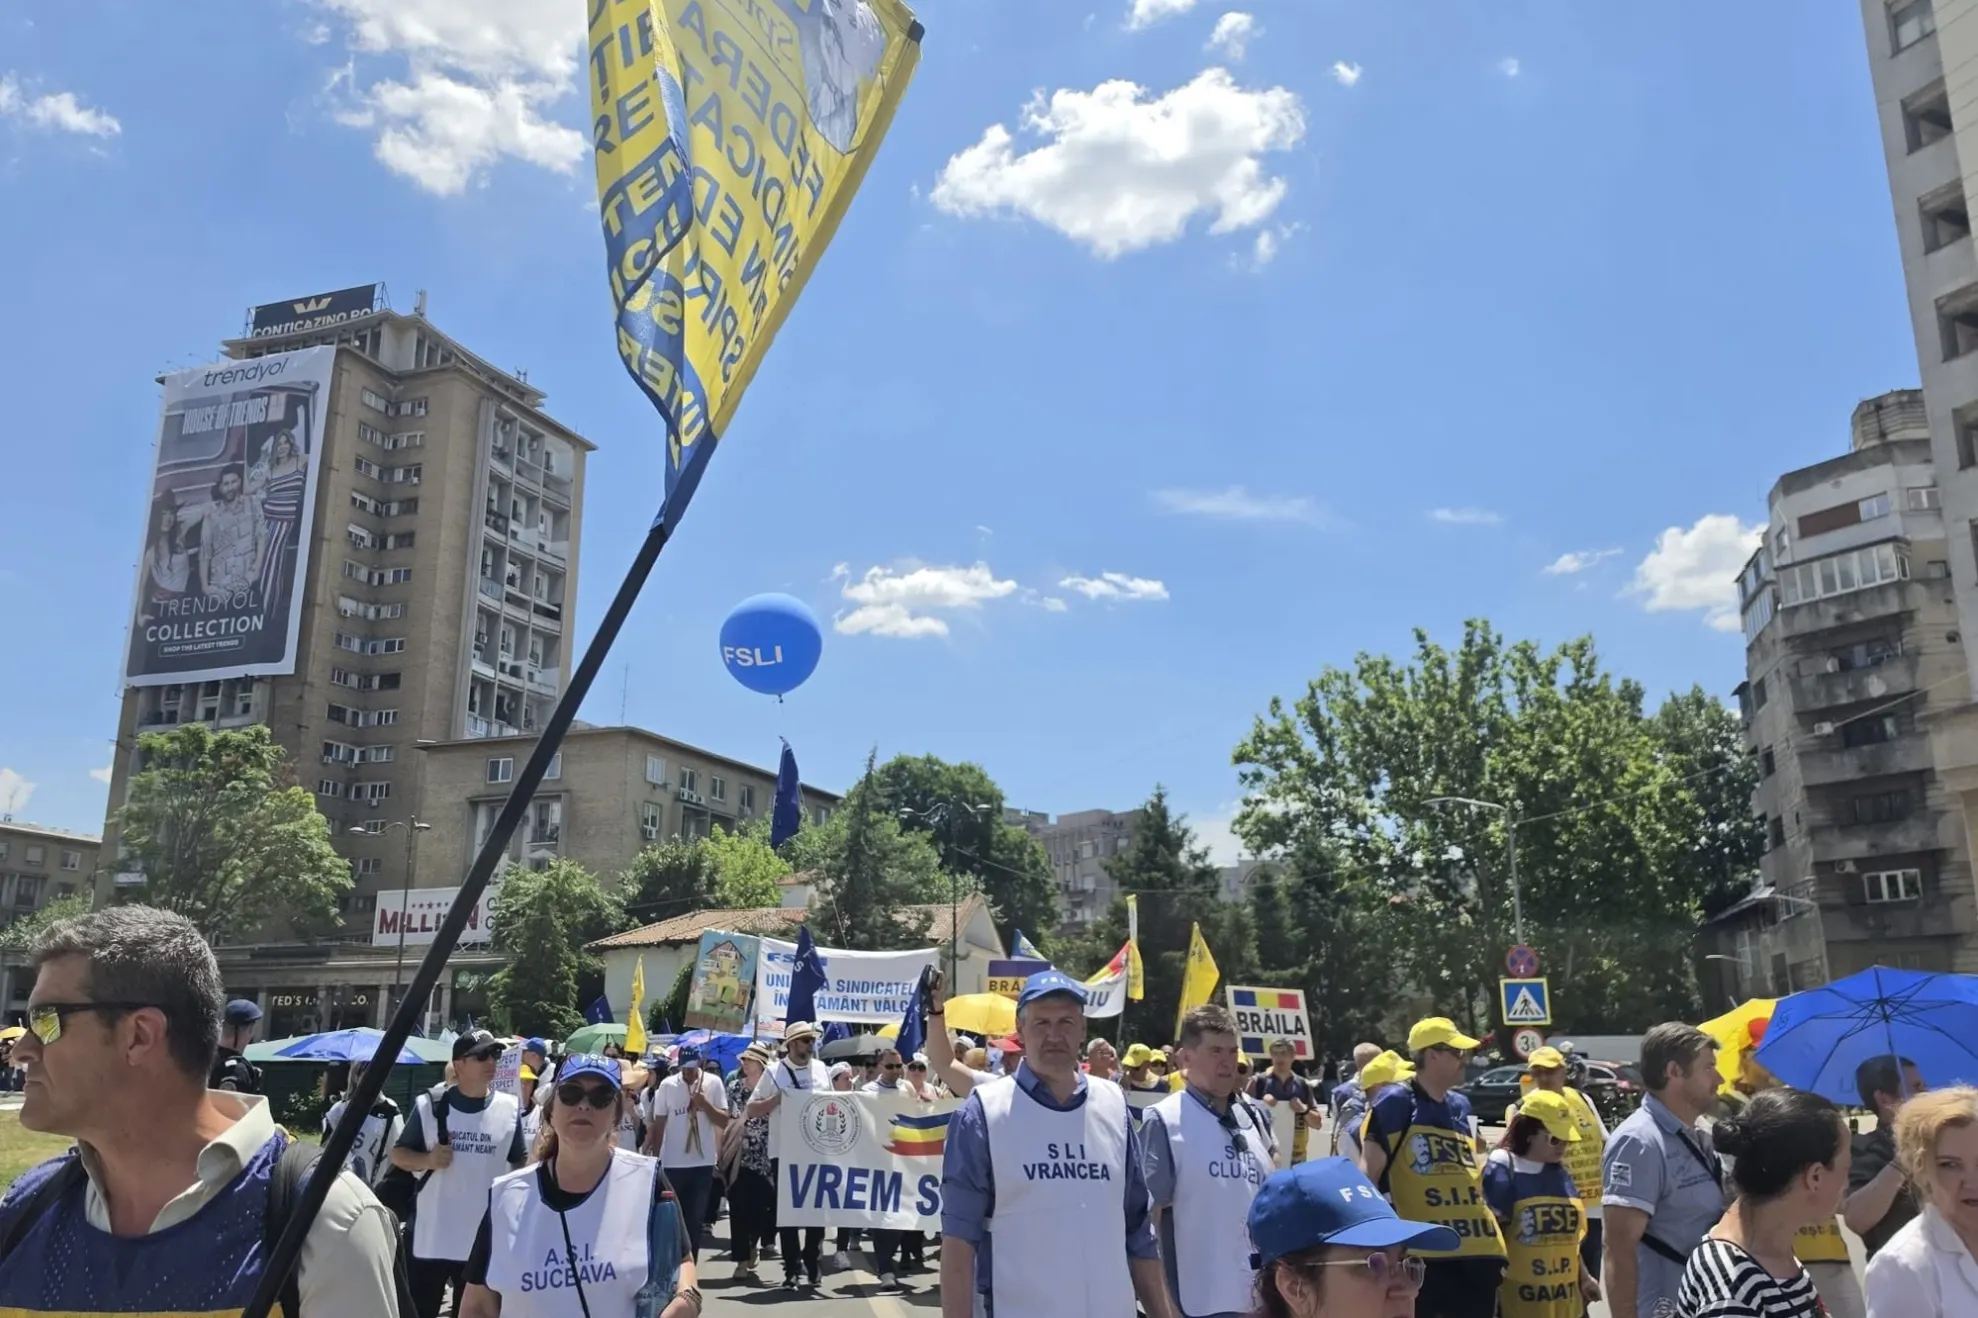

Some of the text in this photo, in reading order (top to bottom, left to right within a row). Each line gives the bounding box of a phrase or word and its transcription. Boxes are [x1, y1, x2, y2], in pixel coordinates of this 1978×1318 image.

[203, 357, 290, 388] trendyol
[154, 591, 258, 618] TRENDYOL
[146, 614, 264, 642] COLLECTION
[723, 645, 783, 667] FSLI
[836, 979, 914, 996] SINDICATEL
[1236, 1008, 1306, 1036] BRĂILA
[1022, 1162, 1110, 1181] VRANCEA
[789, 1163, 904, 1213] VREM
[1534, 1205, 1578, 1232] FSE
[544, 1243, 595, 1267] A.S.I.
[520, 1261, 617, 1292] SUCEAVA
